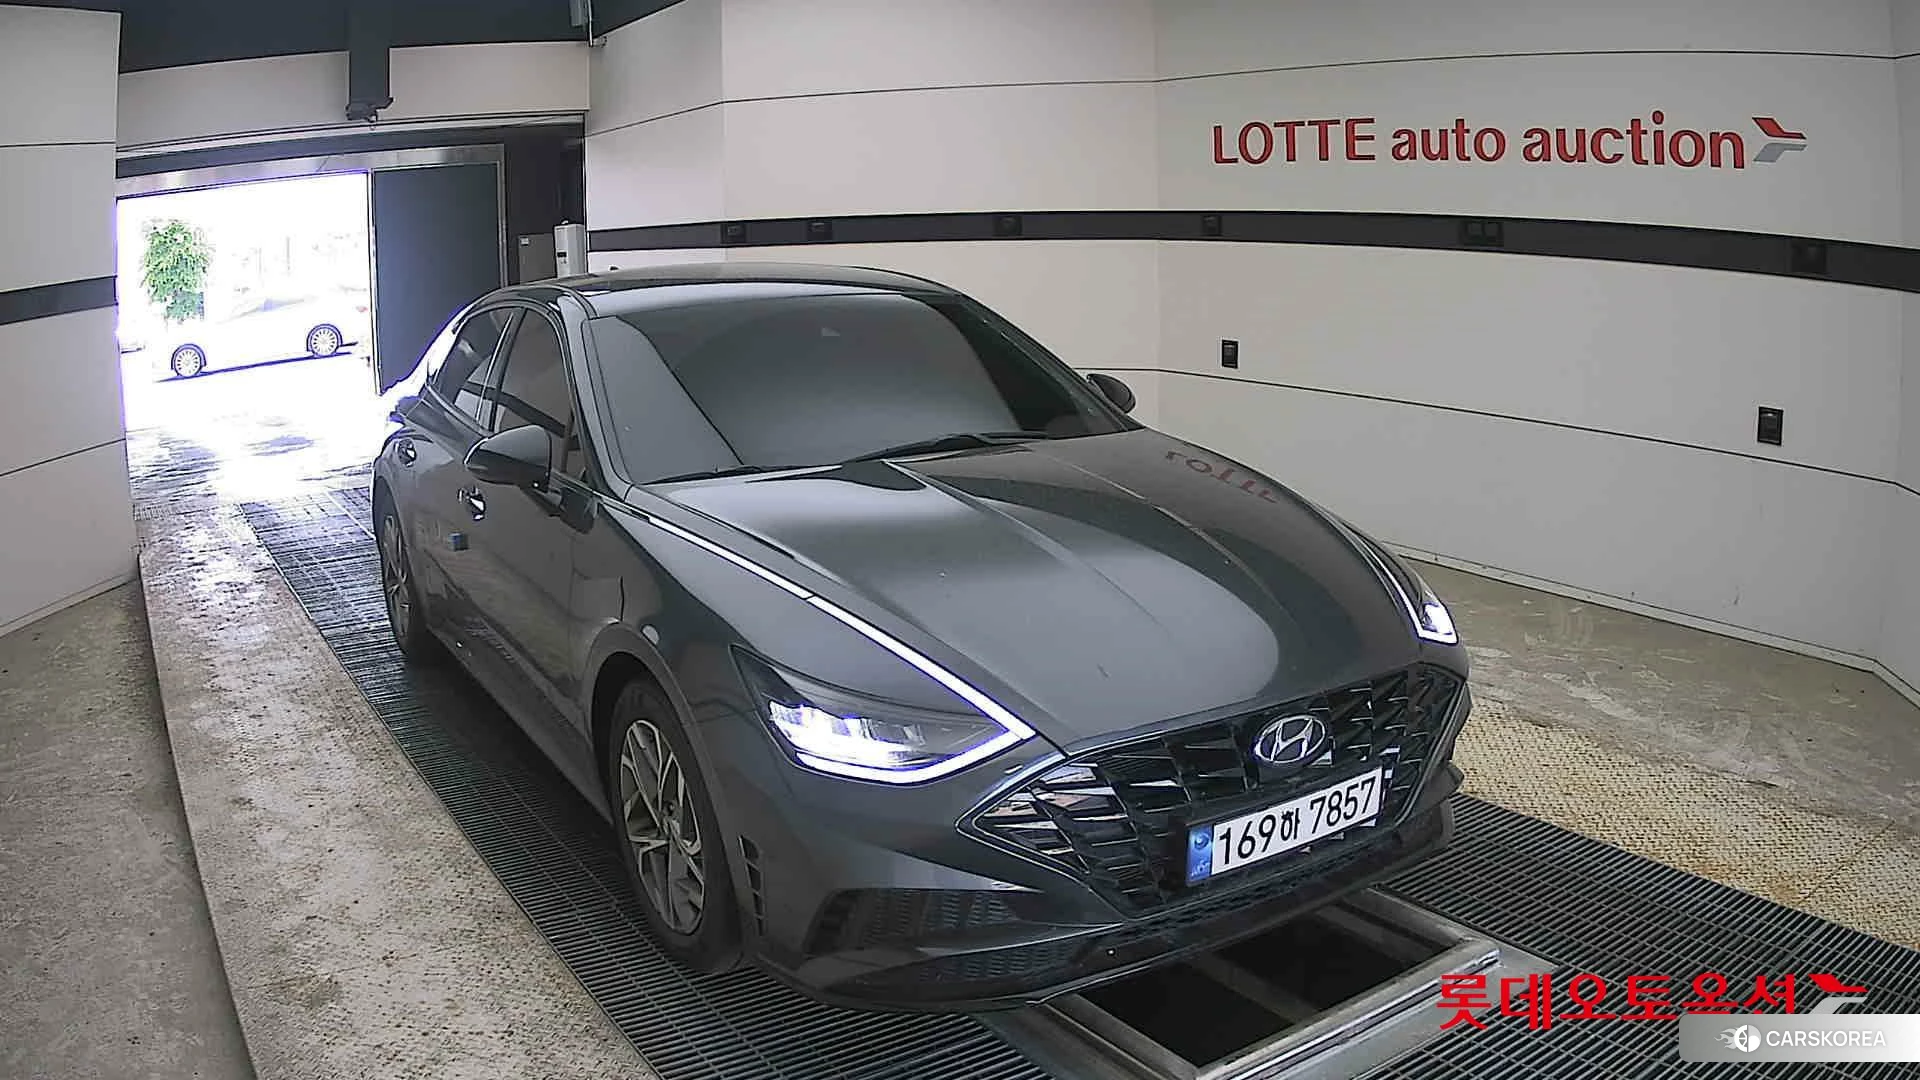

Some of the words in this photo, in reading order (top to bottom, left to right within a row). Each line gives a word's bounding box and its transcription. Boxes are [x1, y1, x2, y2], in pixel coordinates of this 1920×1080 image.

[1213, 117, 1376, 165] LOTTE
[1391, 117, 1507, 163] auto
[1522, 111, 1746, 170] auction
[1218, 807, 1301, 865] 169하
[1309, 776, 1377, 835] 7857
